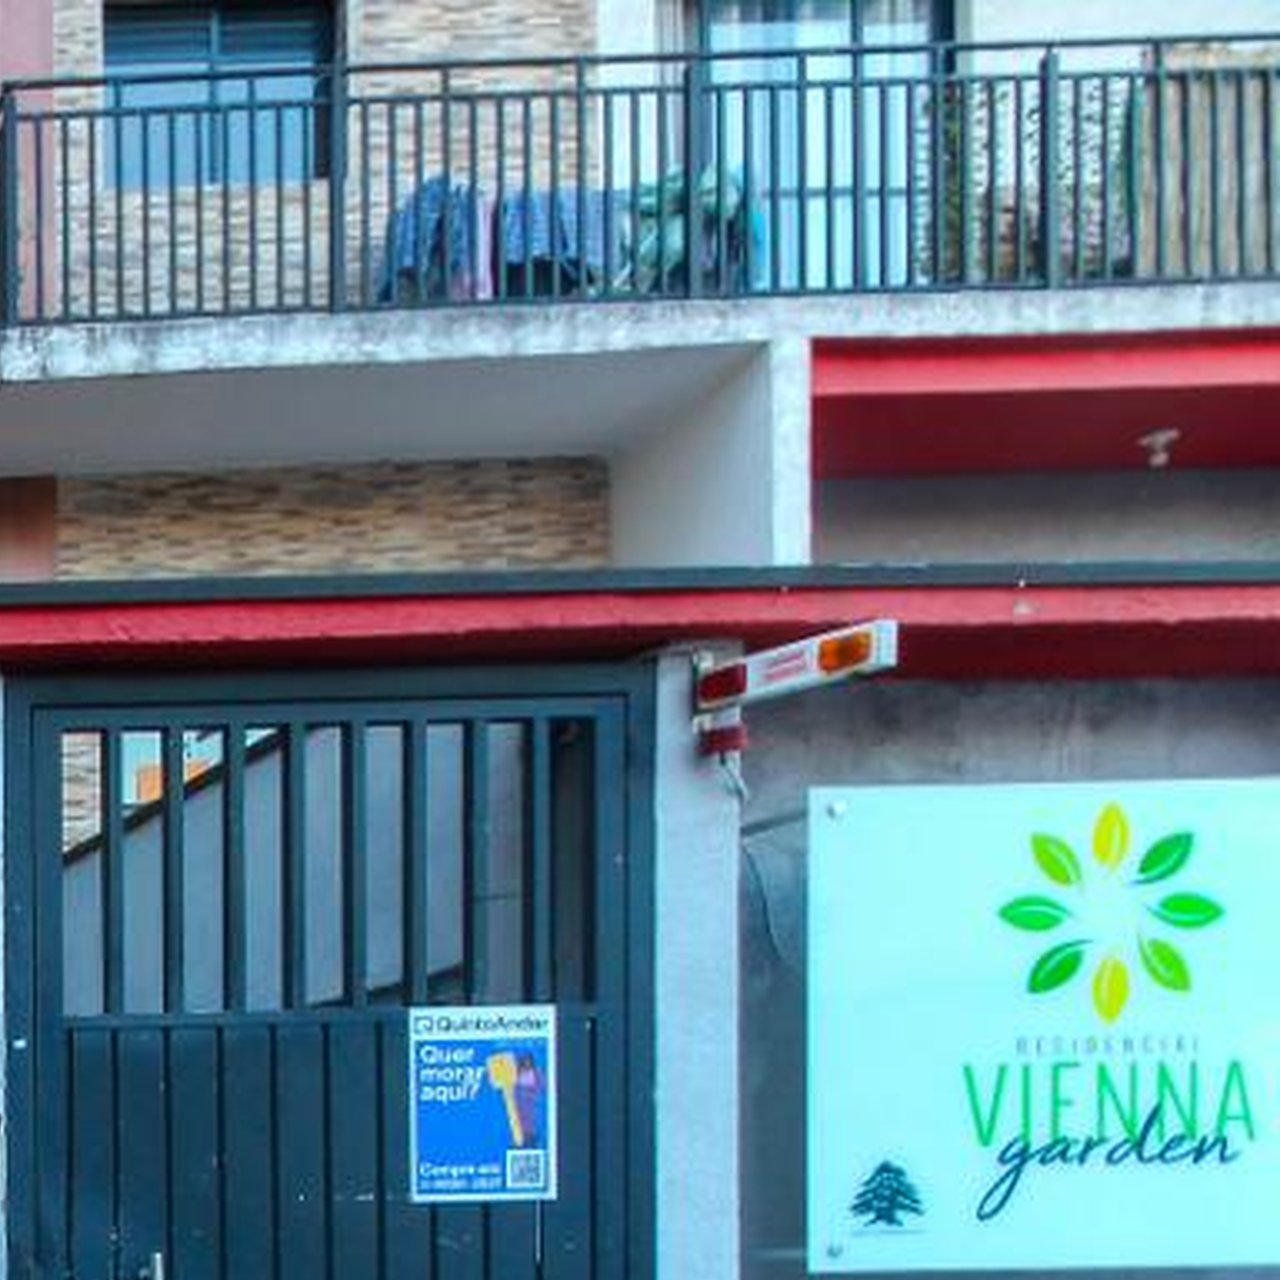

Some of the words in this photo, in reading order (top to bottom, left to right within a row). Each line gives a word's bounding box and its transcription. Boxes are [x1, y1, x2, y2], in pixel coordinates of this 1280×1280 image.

[436, 1014, 550, 1032] QuintoAndar
[419, 1045, 475, 1064] Quer
[419, 1066, 485, 1083] morar
[419, 1083, 480, 1105] aqui?
[962, 1059, 1256, 1147] VIENNA
[975, 1102, 1240, 1221] garden
